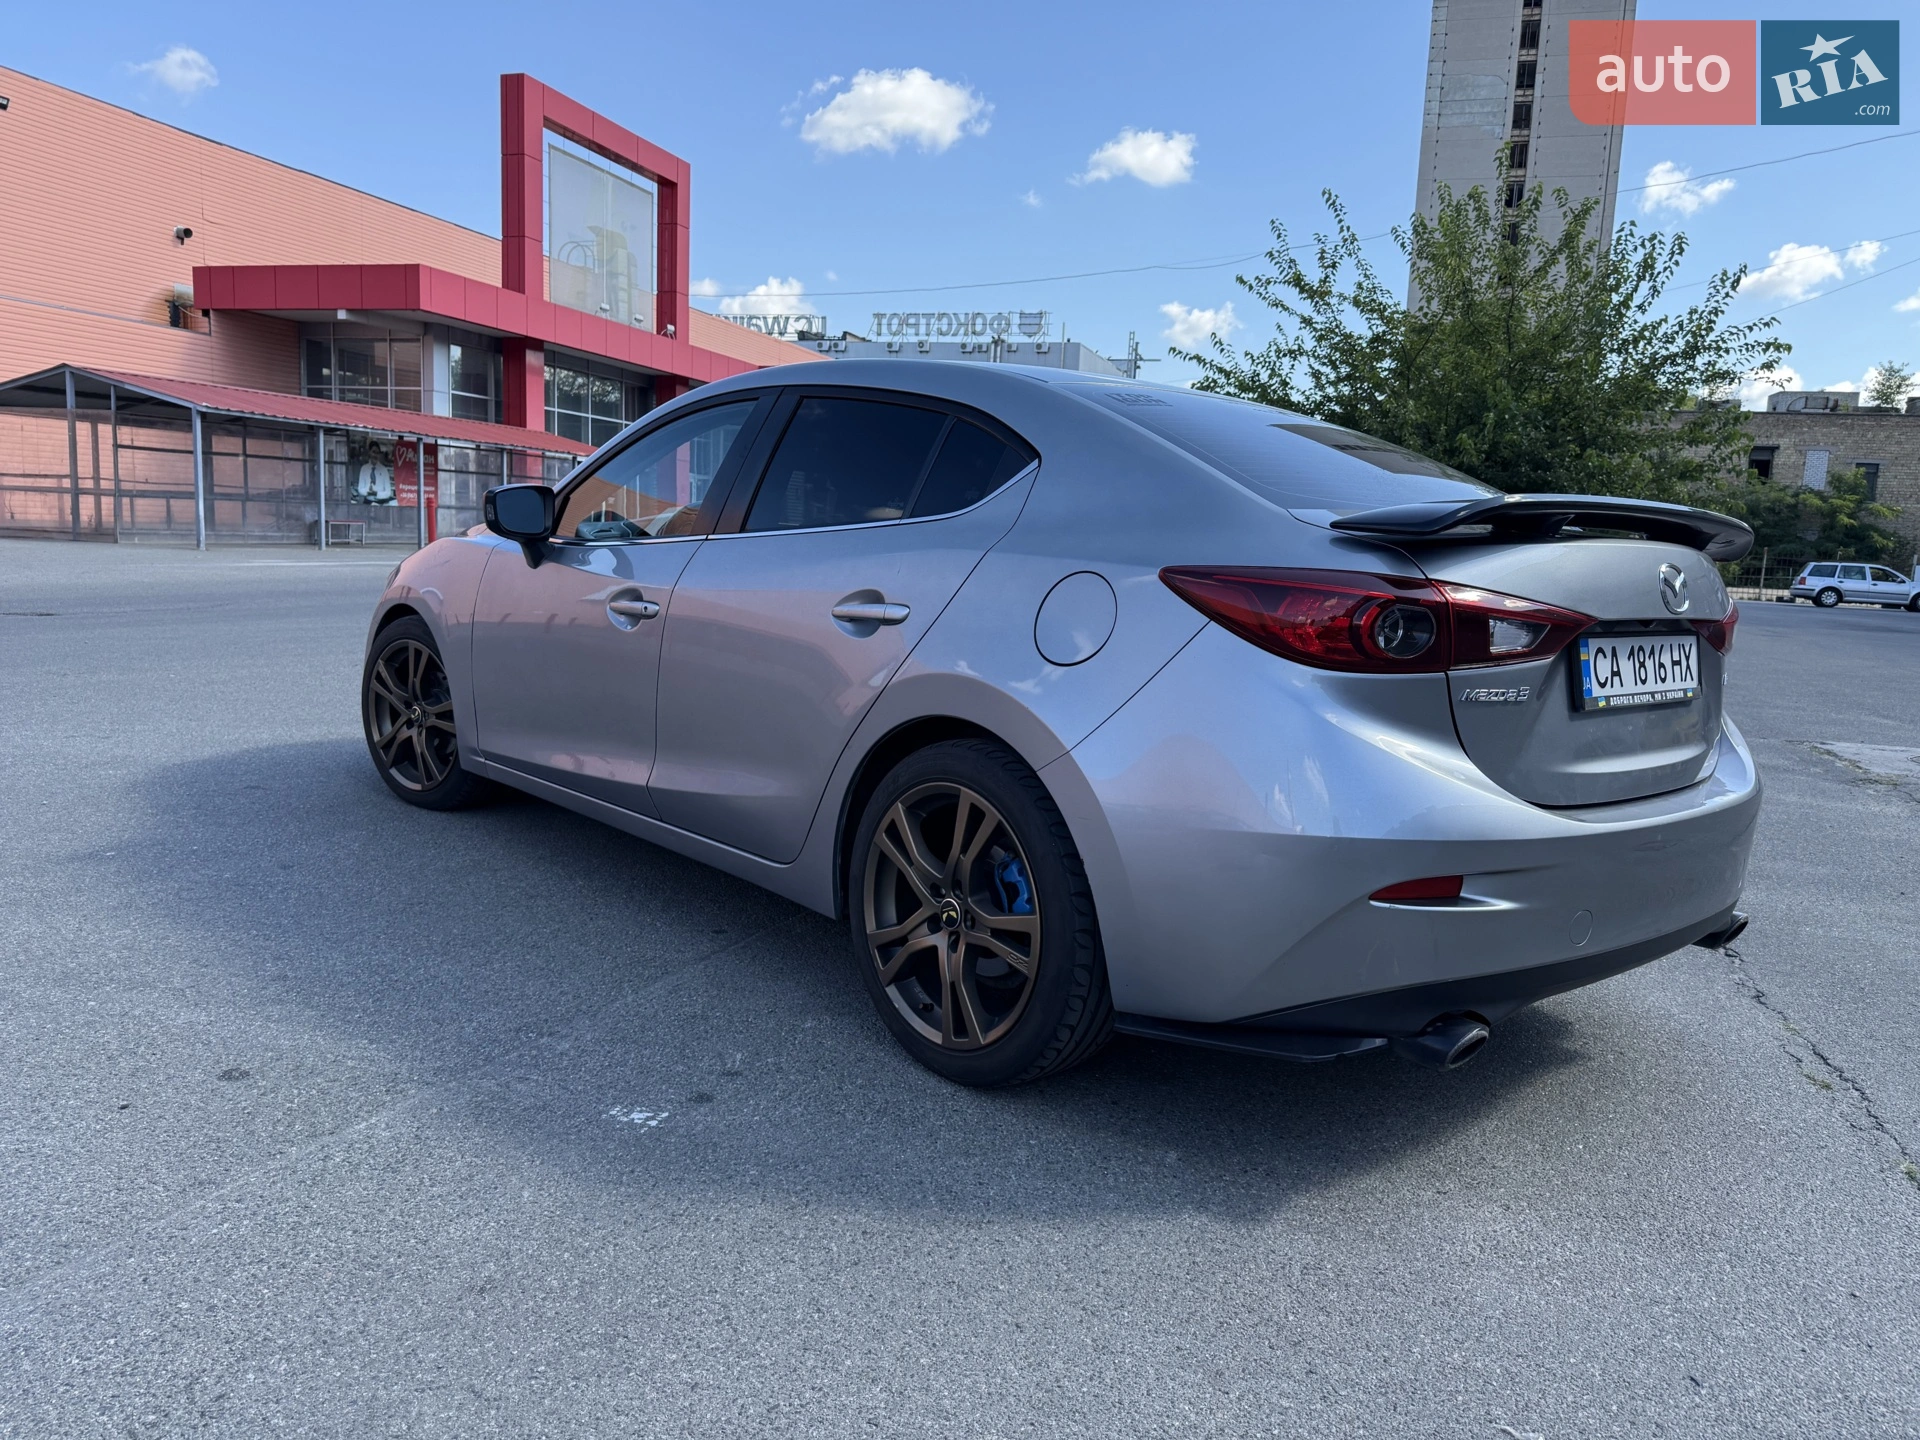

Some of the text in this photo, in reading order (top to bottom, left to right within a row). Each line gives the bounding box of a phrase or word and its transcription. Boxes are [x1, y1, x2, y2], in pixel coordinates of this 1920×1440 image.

[1594, 642, 1695, 689] CA 1816 HX
